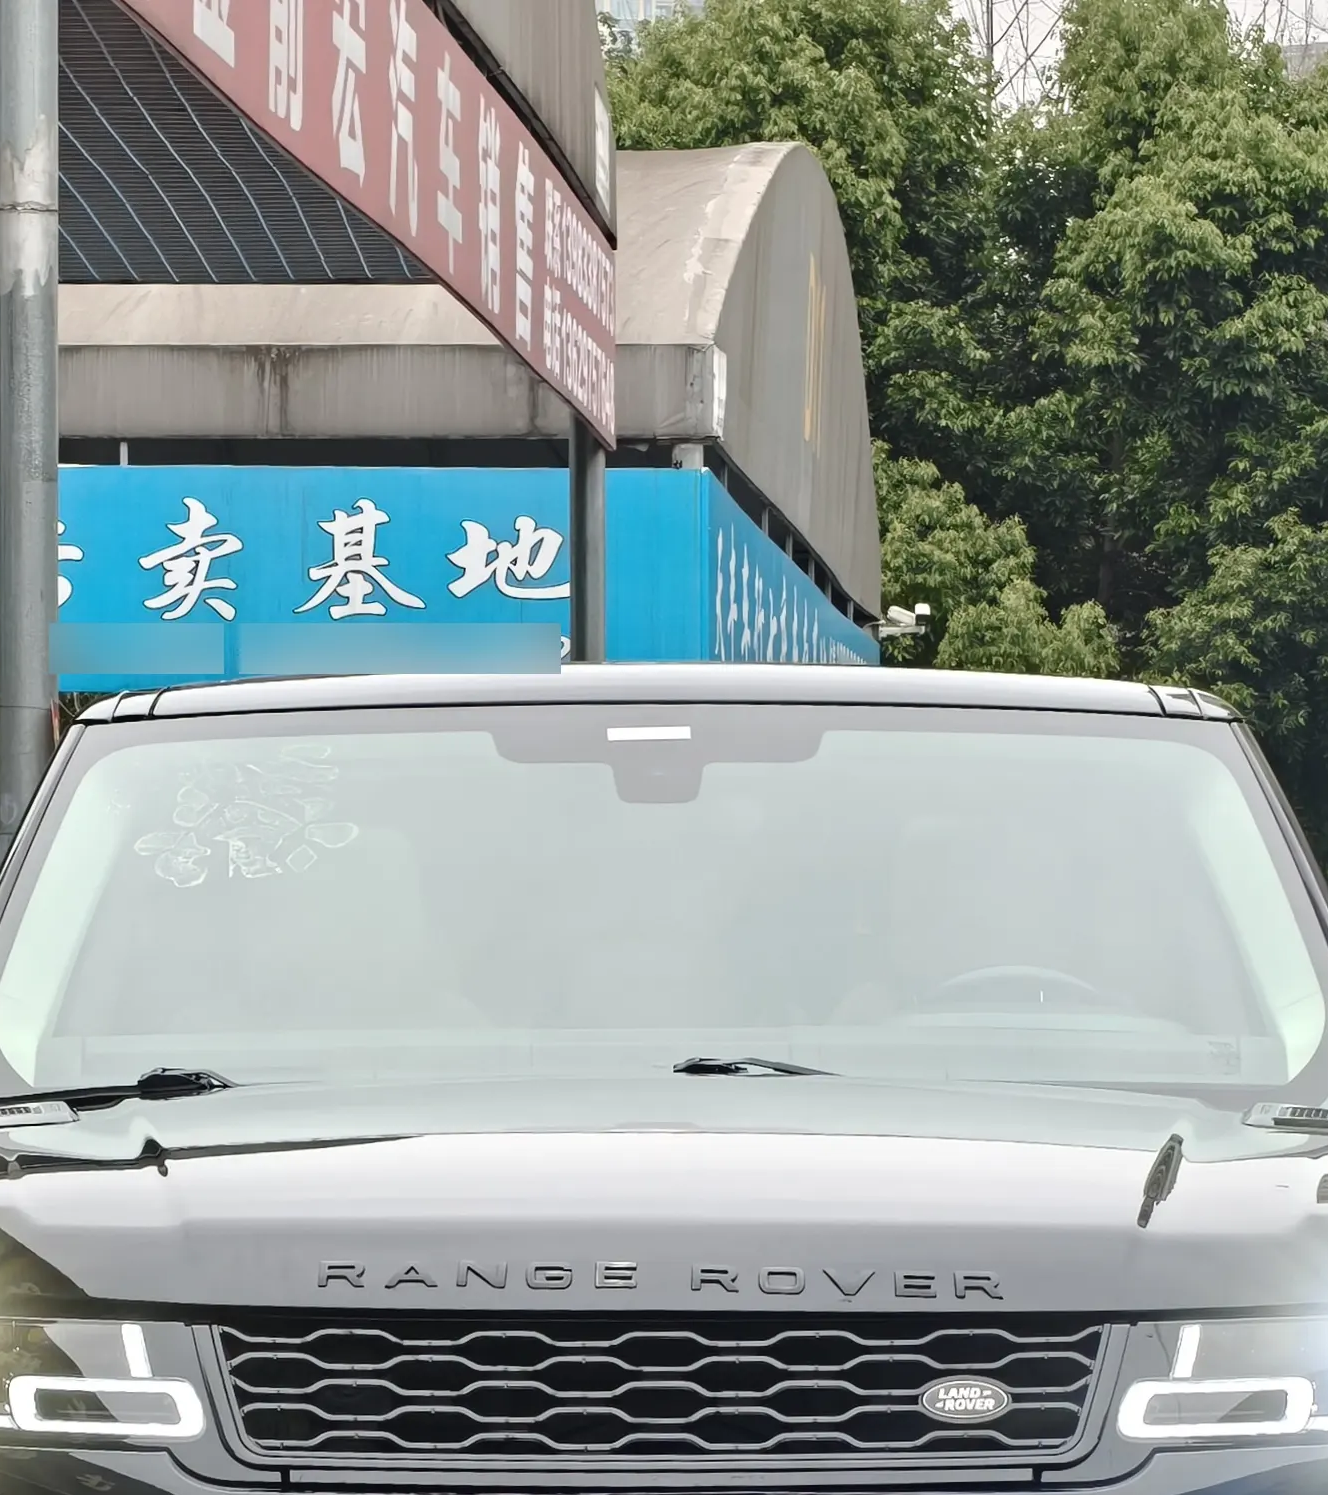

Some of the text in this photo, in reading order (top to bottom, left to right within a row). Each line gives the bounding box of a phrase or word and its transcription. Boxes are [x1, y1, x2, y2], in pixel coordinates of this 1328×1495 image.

[317, 1259, 1004, 1300] RANGE ROVER
[937, 1387, 982, 1399] LAND
[944, 1398, 996, 1411] ROVER
